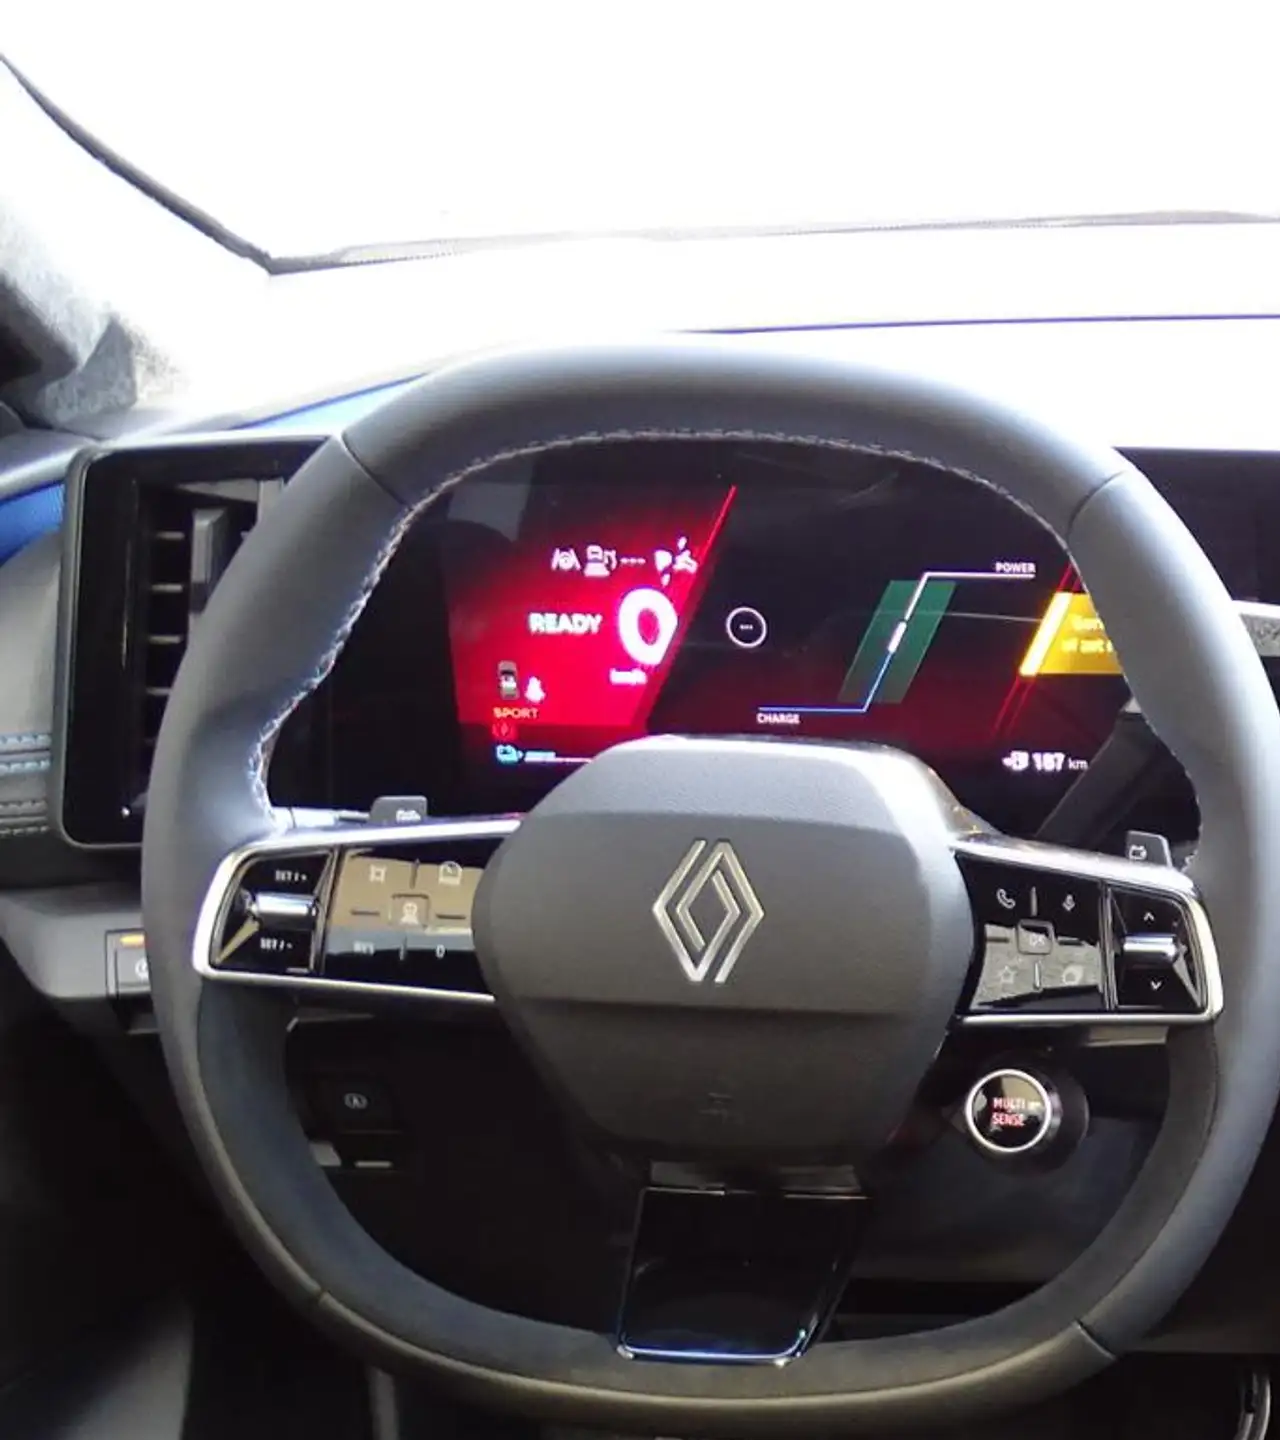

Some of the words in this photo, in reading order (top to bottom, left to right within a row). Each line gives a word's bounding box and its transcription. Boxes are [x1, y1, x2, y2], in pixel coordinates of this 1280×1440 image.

[995, 562, 1036, 574] POWER
[529, 613, 602, 634] READY
[618, 588, 678, 665] 0
[493, 707, 539, 719] SPORT
[756, 712, 801, 725] CHARGE
[1068, 757, 1088, 770] km
[993, 1097, 1026, 1109] MULTI
[992, 1112, 1025, 1127] SENSE
